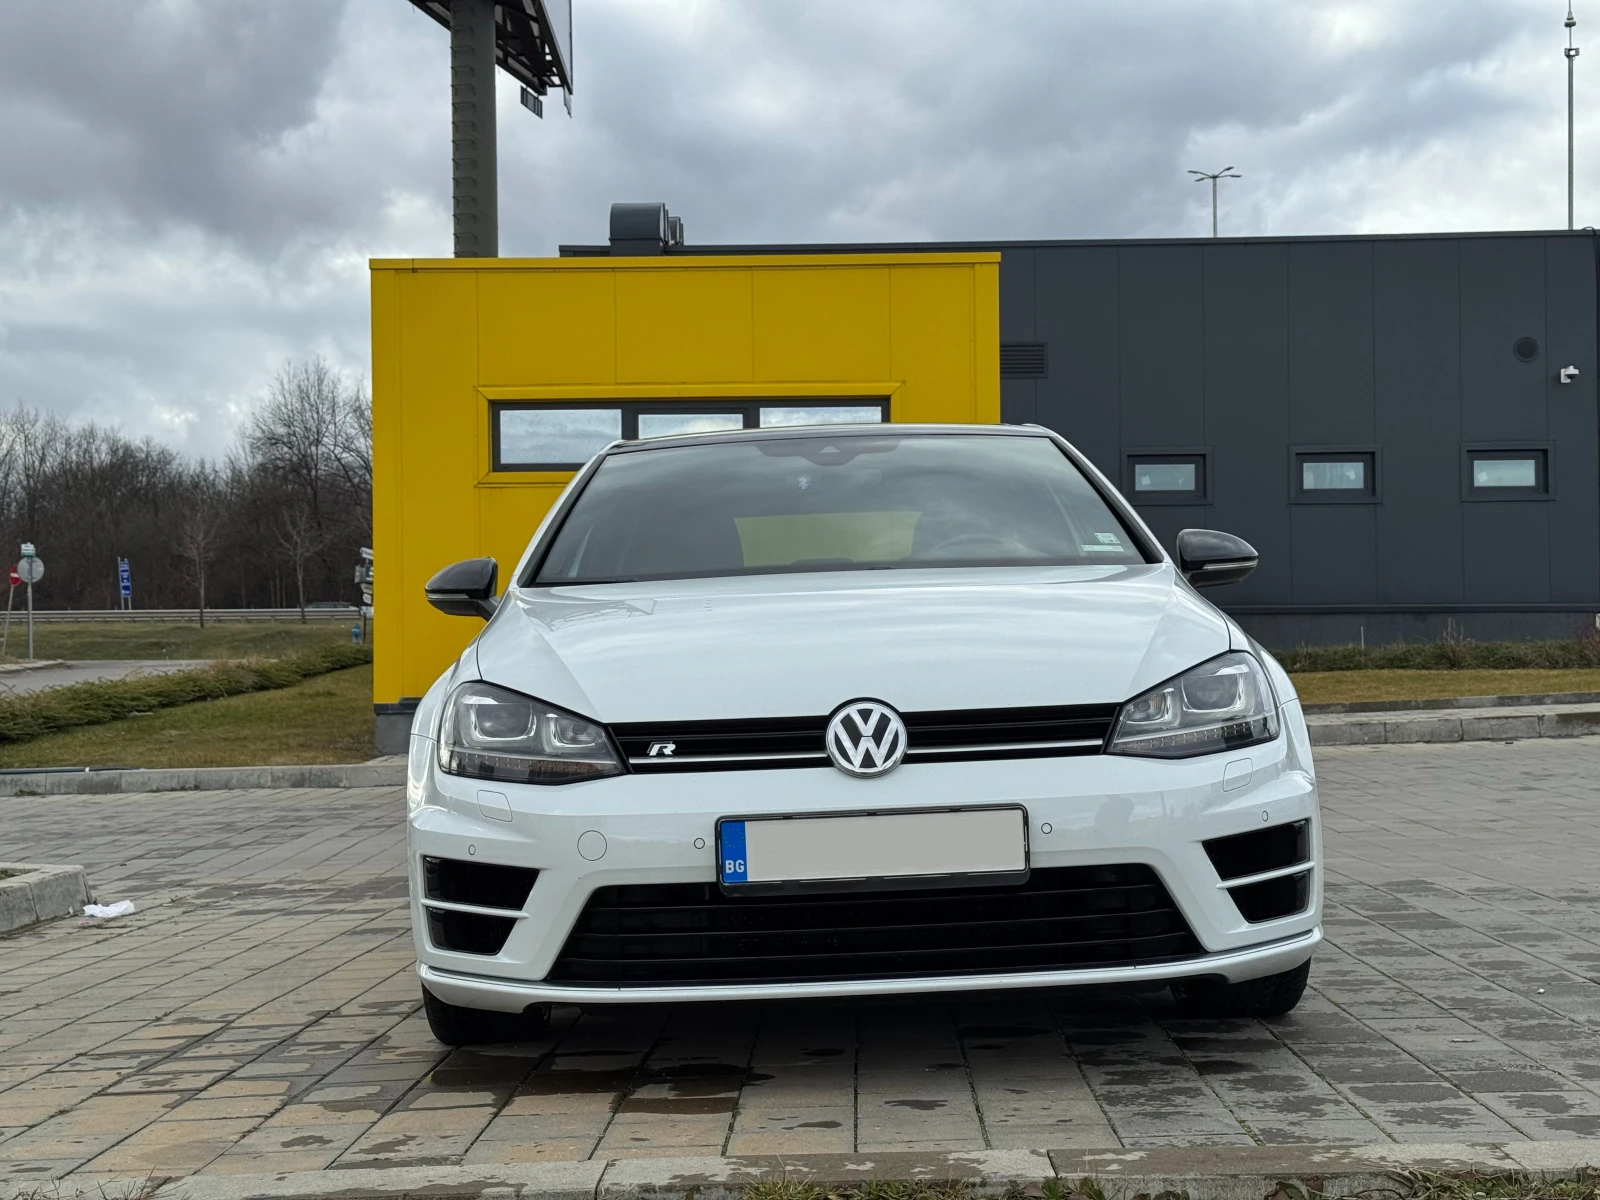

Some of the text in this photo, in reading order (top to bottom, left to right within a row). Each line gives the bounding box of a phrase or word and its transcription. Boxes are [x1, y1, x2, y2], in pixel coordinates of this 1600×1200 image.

[828, 703, 905, 772] VW
[647, 741, 676, 756] R
[725, 859, 746, 873] BG
